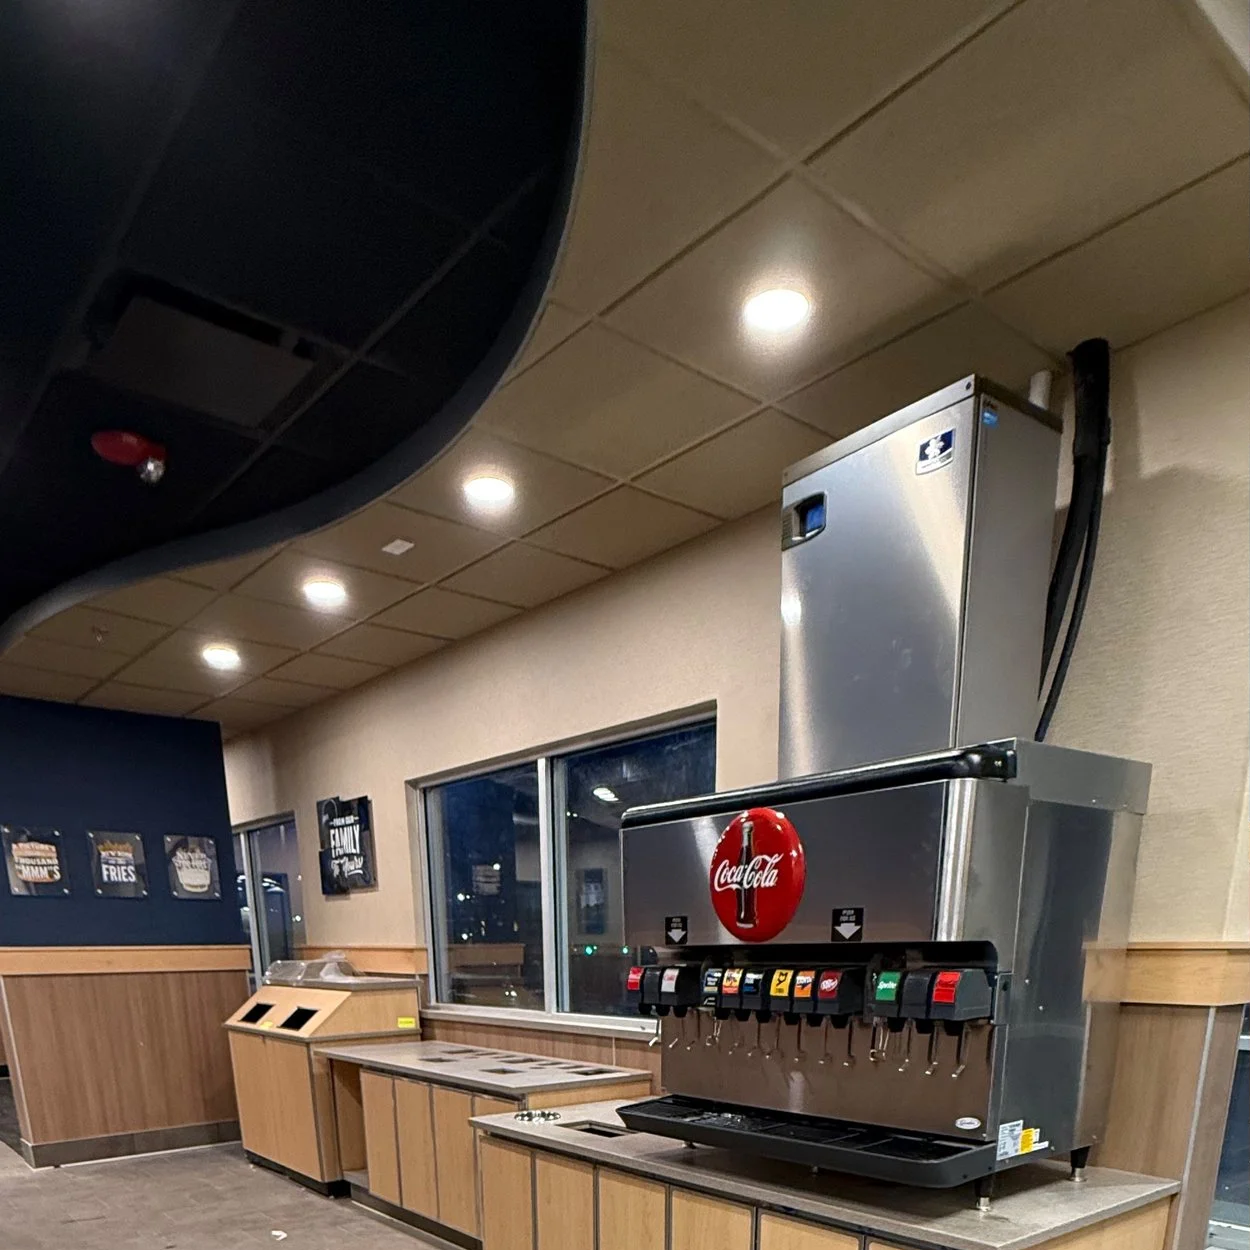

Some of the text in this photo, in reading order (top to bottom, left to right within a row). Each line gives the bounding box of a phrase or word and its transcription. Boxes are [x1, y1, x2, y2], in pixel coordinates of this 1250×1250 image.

[330, 824, 360, 858] FAMILY
[101, 864, 136, 882] FRIES
[714, 853, 784, 892] Coca-Cola
